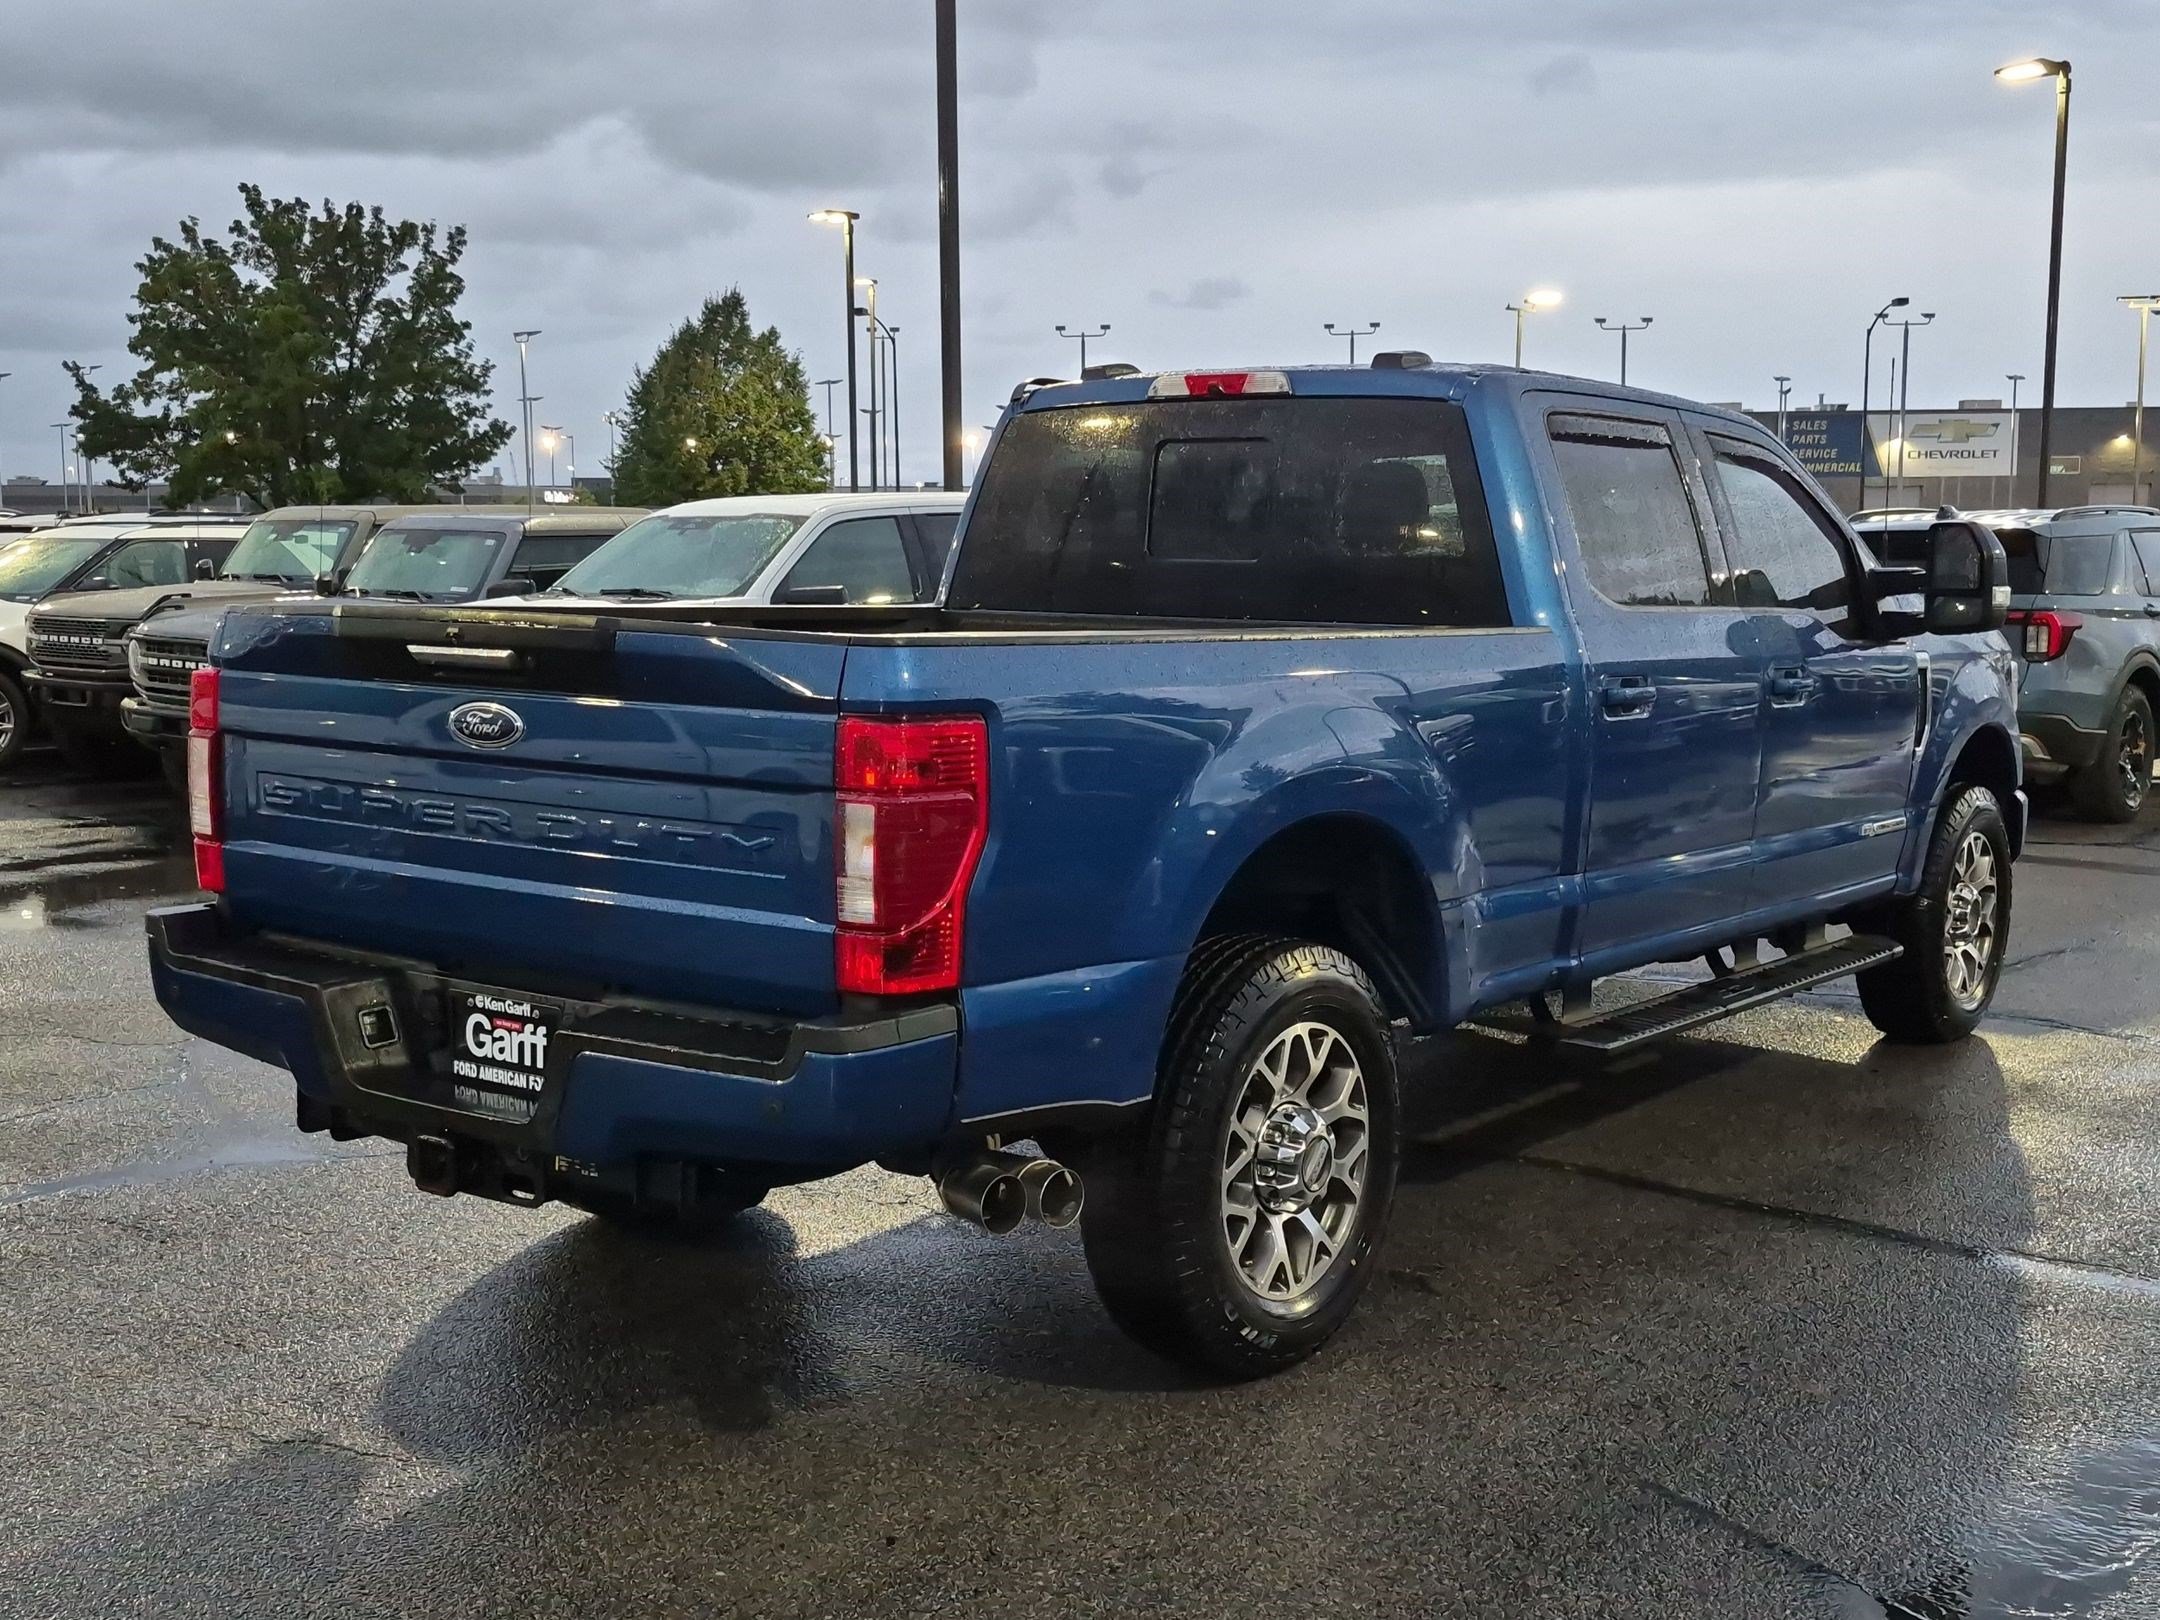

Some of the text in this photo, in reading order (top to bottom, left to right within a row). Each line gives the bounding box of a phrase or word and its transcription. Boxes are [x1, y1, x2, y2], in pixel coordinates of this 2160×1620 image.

[1792, 420, 1828, 431] SALES
[1792, 434, 1827, 445] PARTS
[1791, 448, 1838, 459] SERVICE
[1907, 449, 2000, 460] CHEVROLET
[1801, 462, 1863, 473] MMERCIAL
[40, 634, 103, 645] BRONCO
[148, 657, 212, 670] BRONC
[462, 710, 503, 737] Ford
[465, 1012, 547, 1069] Garff
[453, 1060, 478, 1078] FORD
[479, 1065, 527, 1089] AMERICAN
